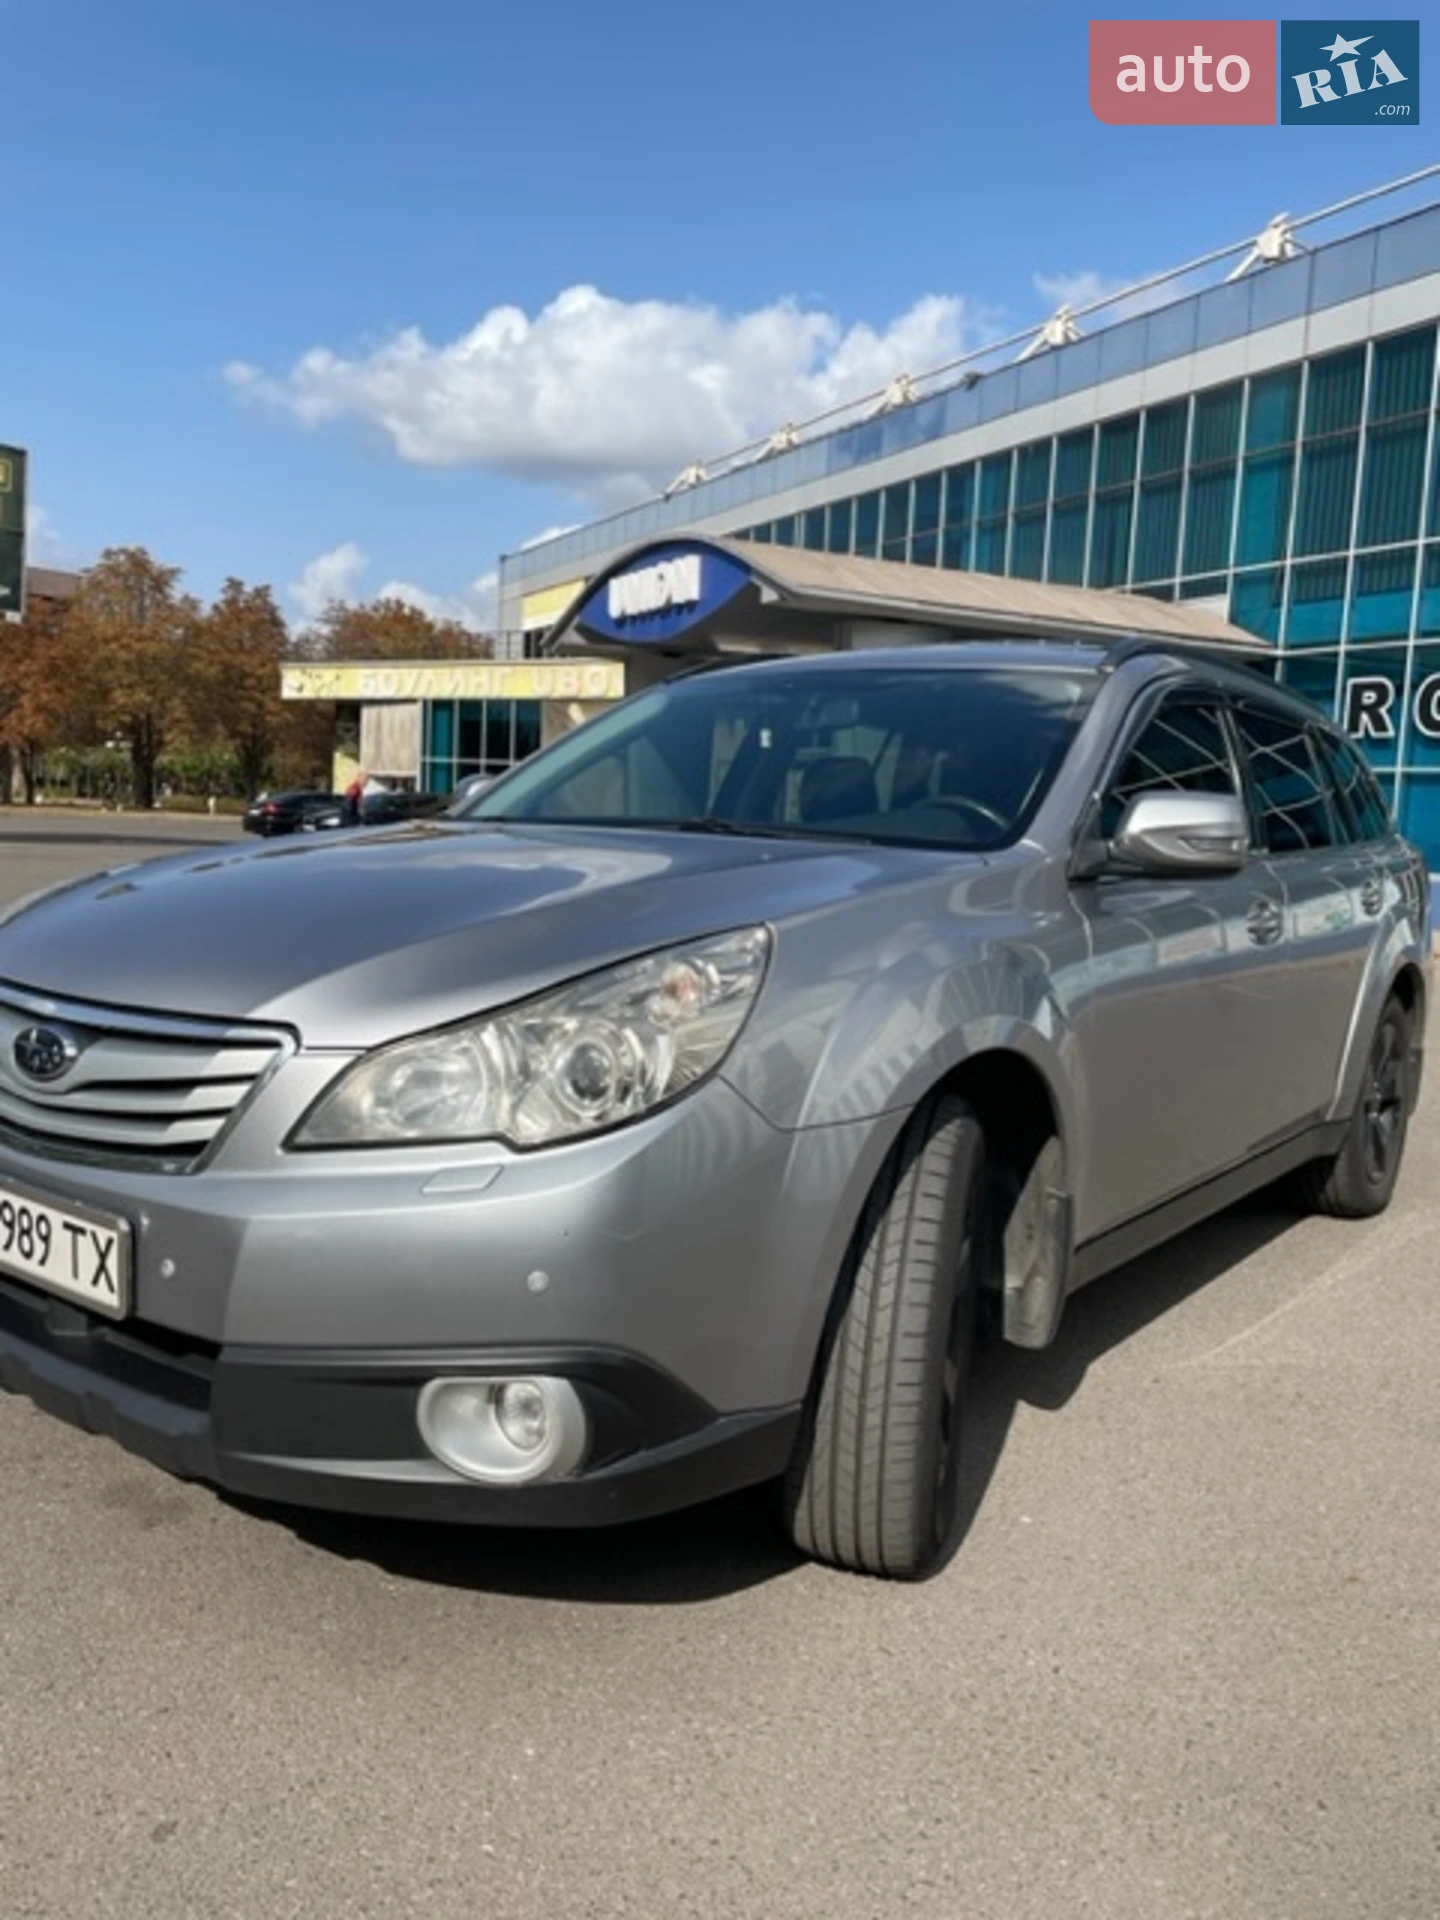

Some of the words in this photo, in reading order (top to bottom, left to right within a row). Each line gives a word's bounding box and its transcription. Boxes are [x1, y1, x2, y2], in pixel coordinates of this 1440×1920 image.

[357, 666, 514, 697] БОУЛИНГ
[0, 1200, 52, 1267] 989
[62, 1220, 117, 1294] TX
